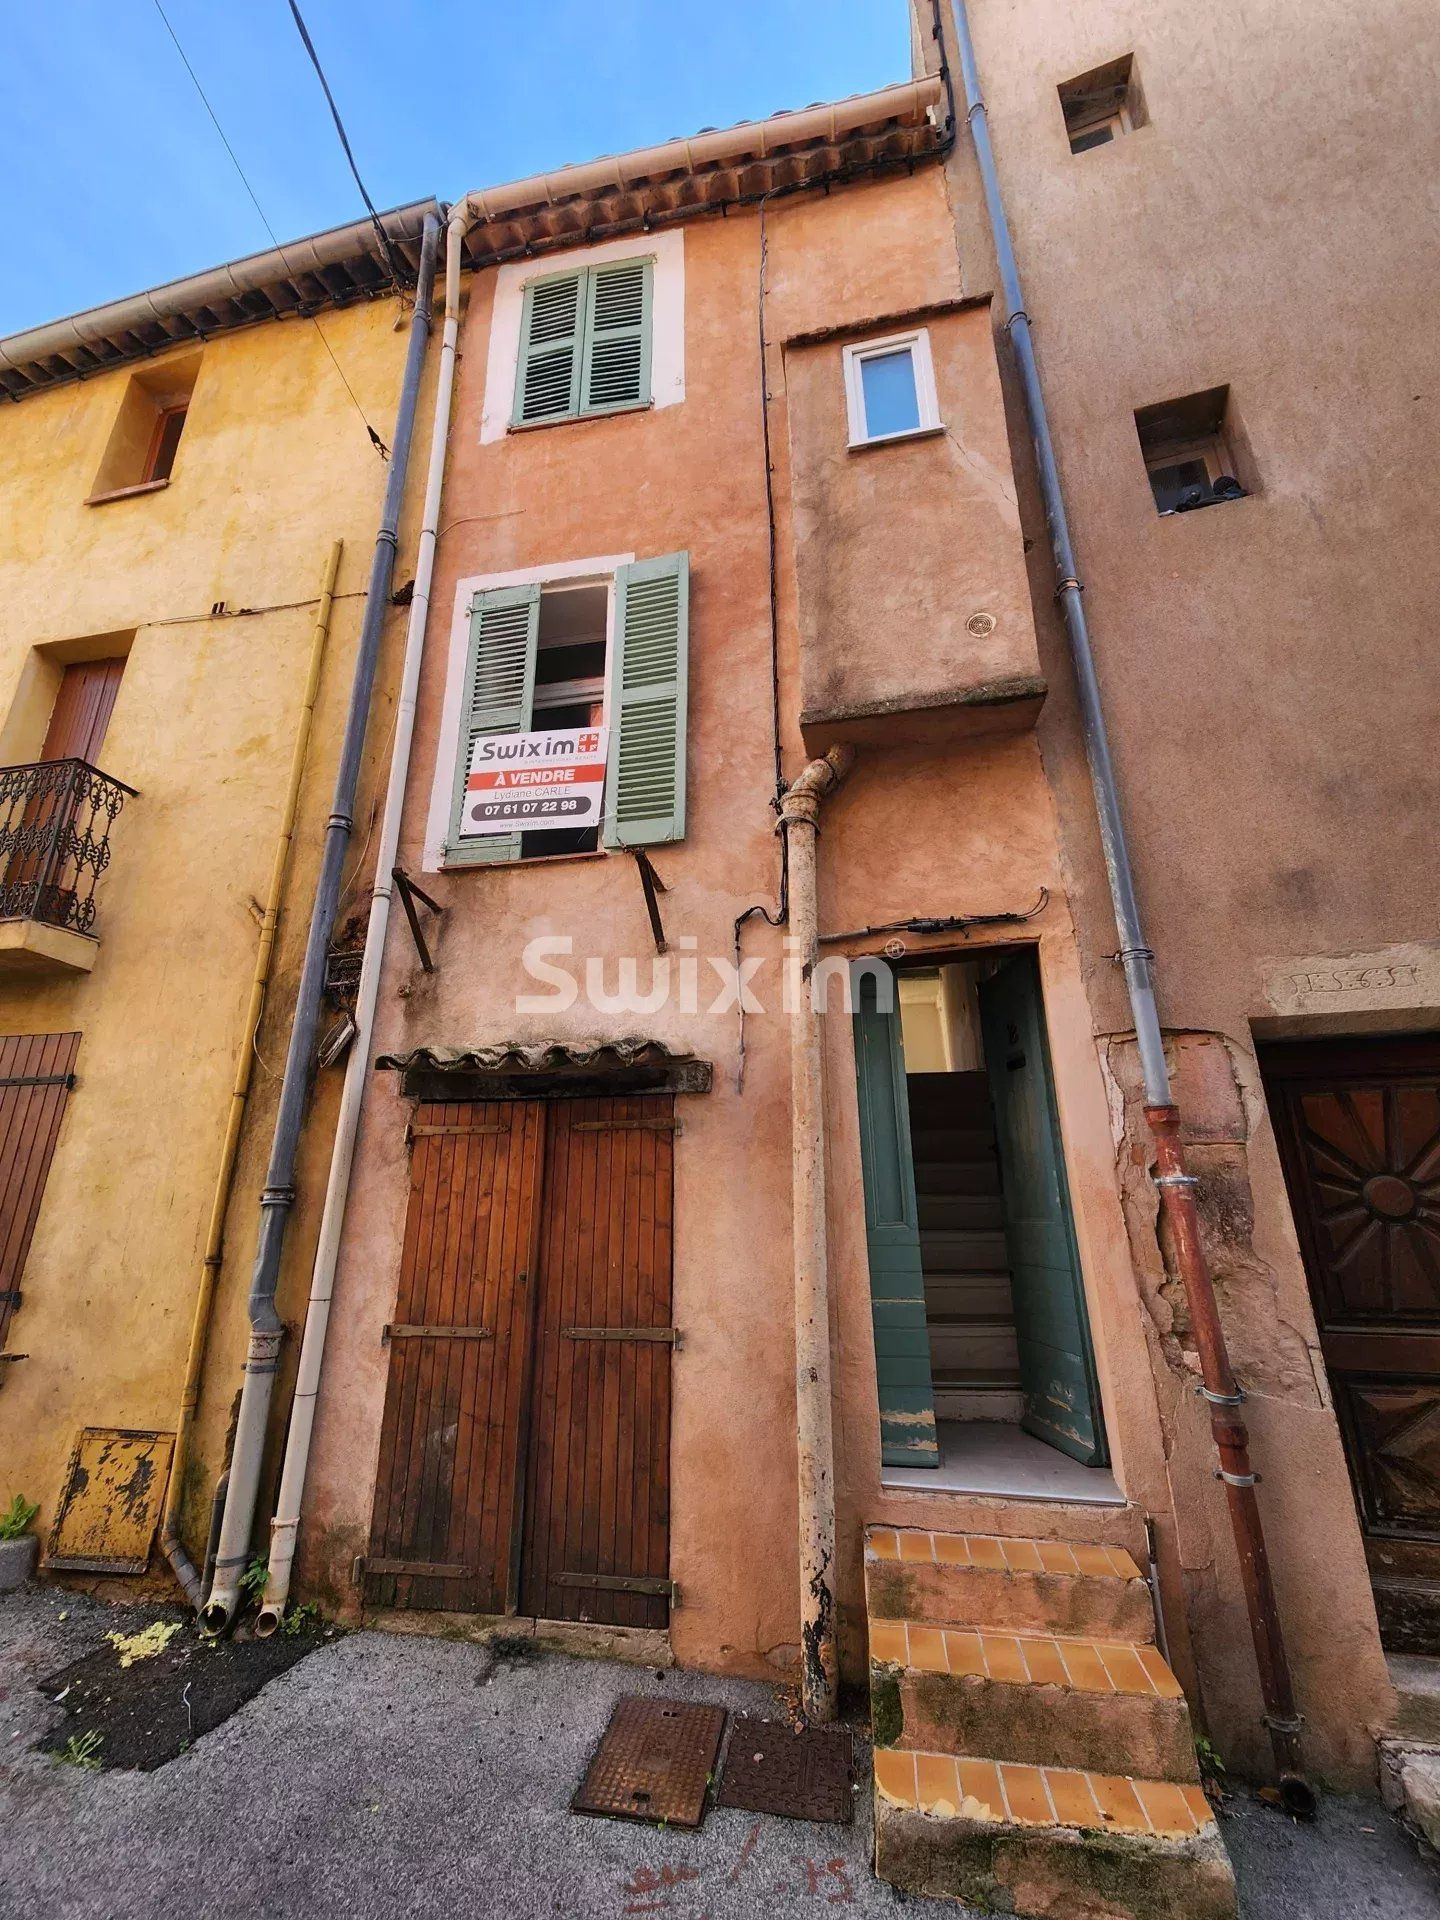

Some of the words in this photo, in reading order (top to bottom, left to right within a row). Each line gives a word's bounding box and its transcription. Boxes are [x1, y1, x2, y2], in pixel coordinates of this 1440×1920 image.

[479, 737, 575, 762] Swixim
[511, 769, 576, 785] VENDRE
[494, 789, 532, 801] Lydiane
[534, 786, 571, 797] CARLE
[484, 805, 500, 816] 07
[503, 804, 518, 814] 61
[522, 802, 538, 813] 07
[541, 801, 557, 812] 22
[560, 800, 577, 811] 98
